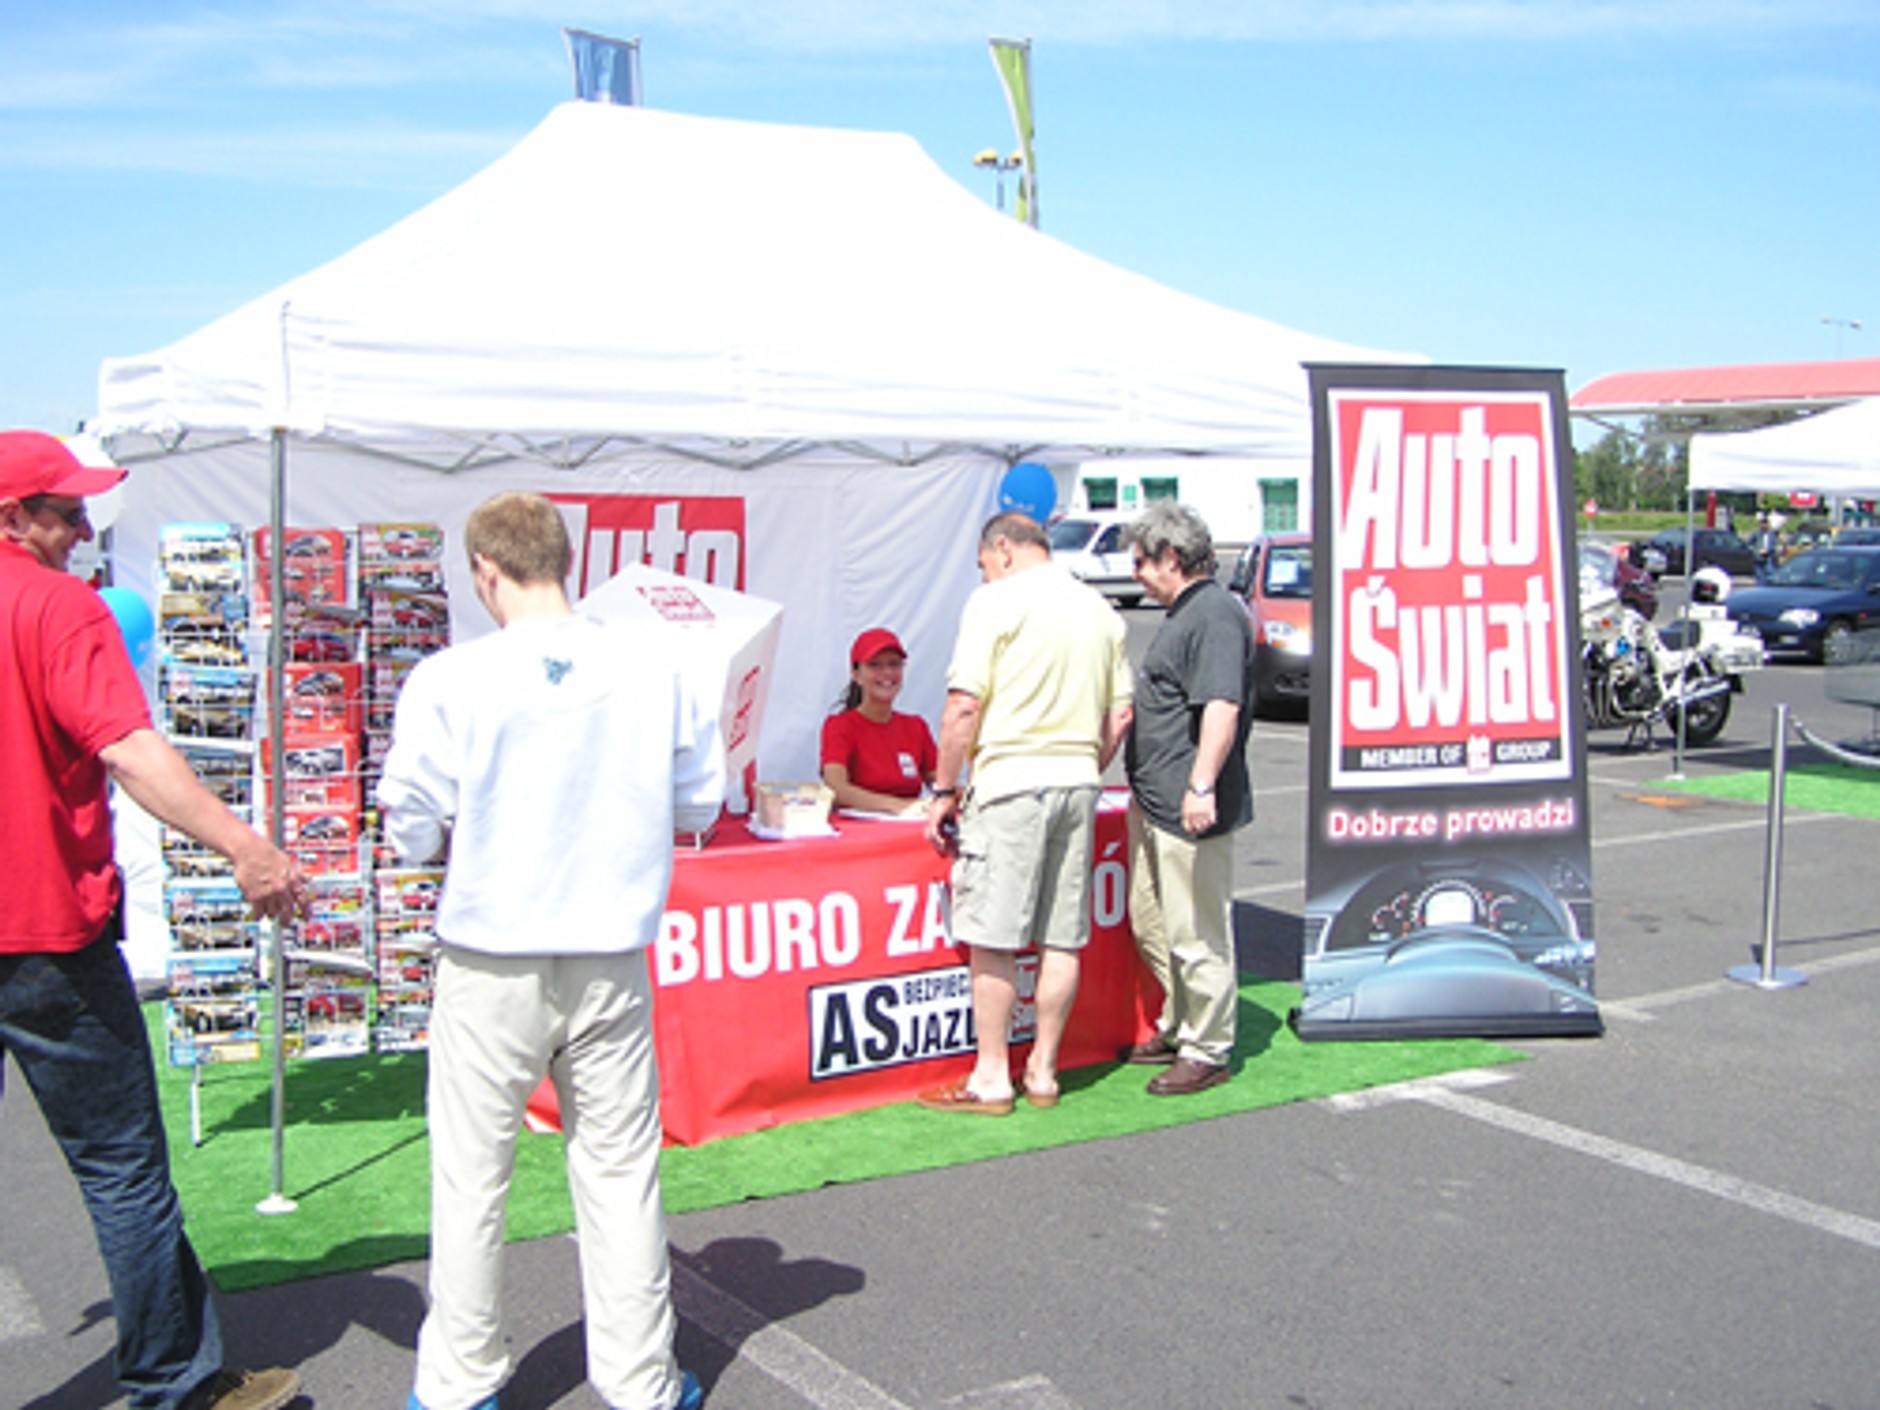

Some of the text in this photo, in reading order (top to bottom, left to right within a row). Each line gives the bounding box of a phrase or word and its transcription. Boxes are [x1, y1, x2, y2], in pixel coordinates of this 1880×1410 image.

[1340, 405, 1540, 570] Auto
[1348, 574, 1556, 731] Świat
[1361, 748, 1438, 769] MEMBER
[1440, 744, 1463, 765] OF
[1496, 741, 1551, 762] GROUP
[1328, 797, 1574, 840] Dobrze prowadzi
[655, 891, 862, 988] BIURO
[816, 984, 900, 1072] AS
[903, 972, 972, 1005] BEZPIEC
